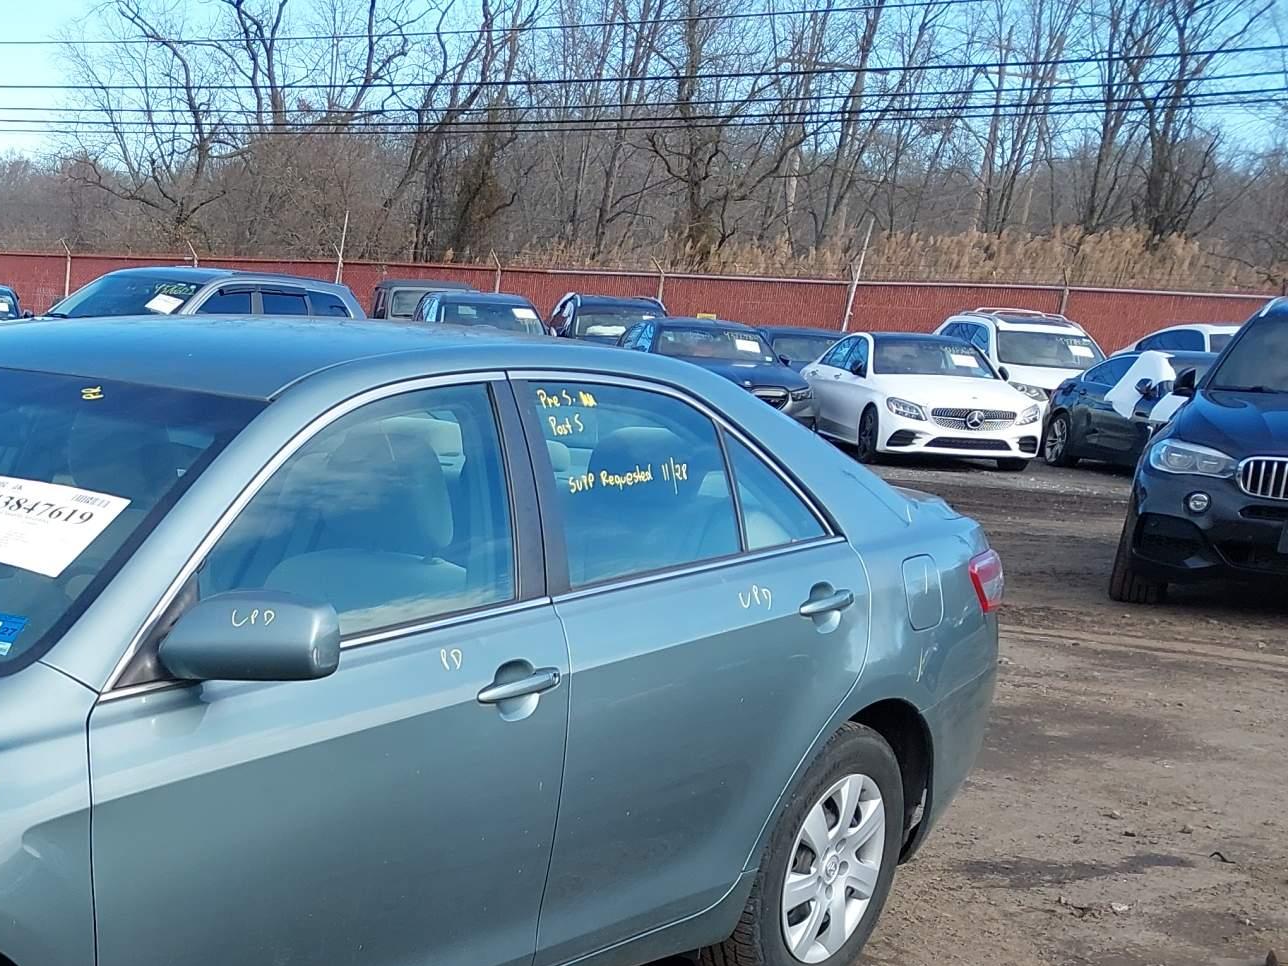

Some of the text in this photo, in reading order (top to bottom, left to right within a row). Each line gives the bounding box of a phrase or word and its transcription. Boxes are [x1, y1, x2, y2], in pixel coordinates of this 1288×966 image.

[537, 389, 561, 409] Pre
[549, 413, 584, 436] Post S
[600, 463, 654, 491] Requested
[661, 457, 688, 495] 11/28
